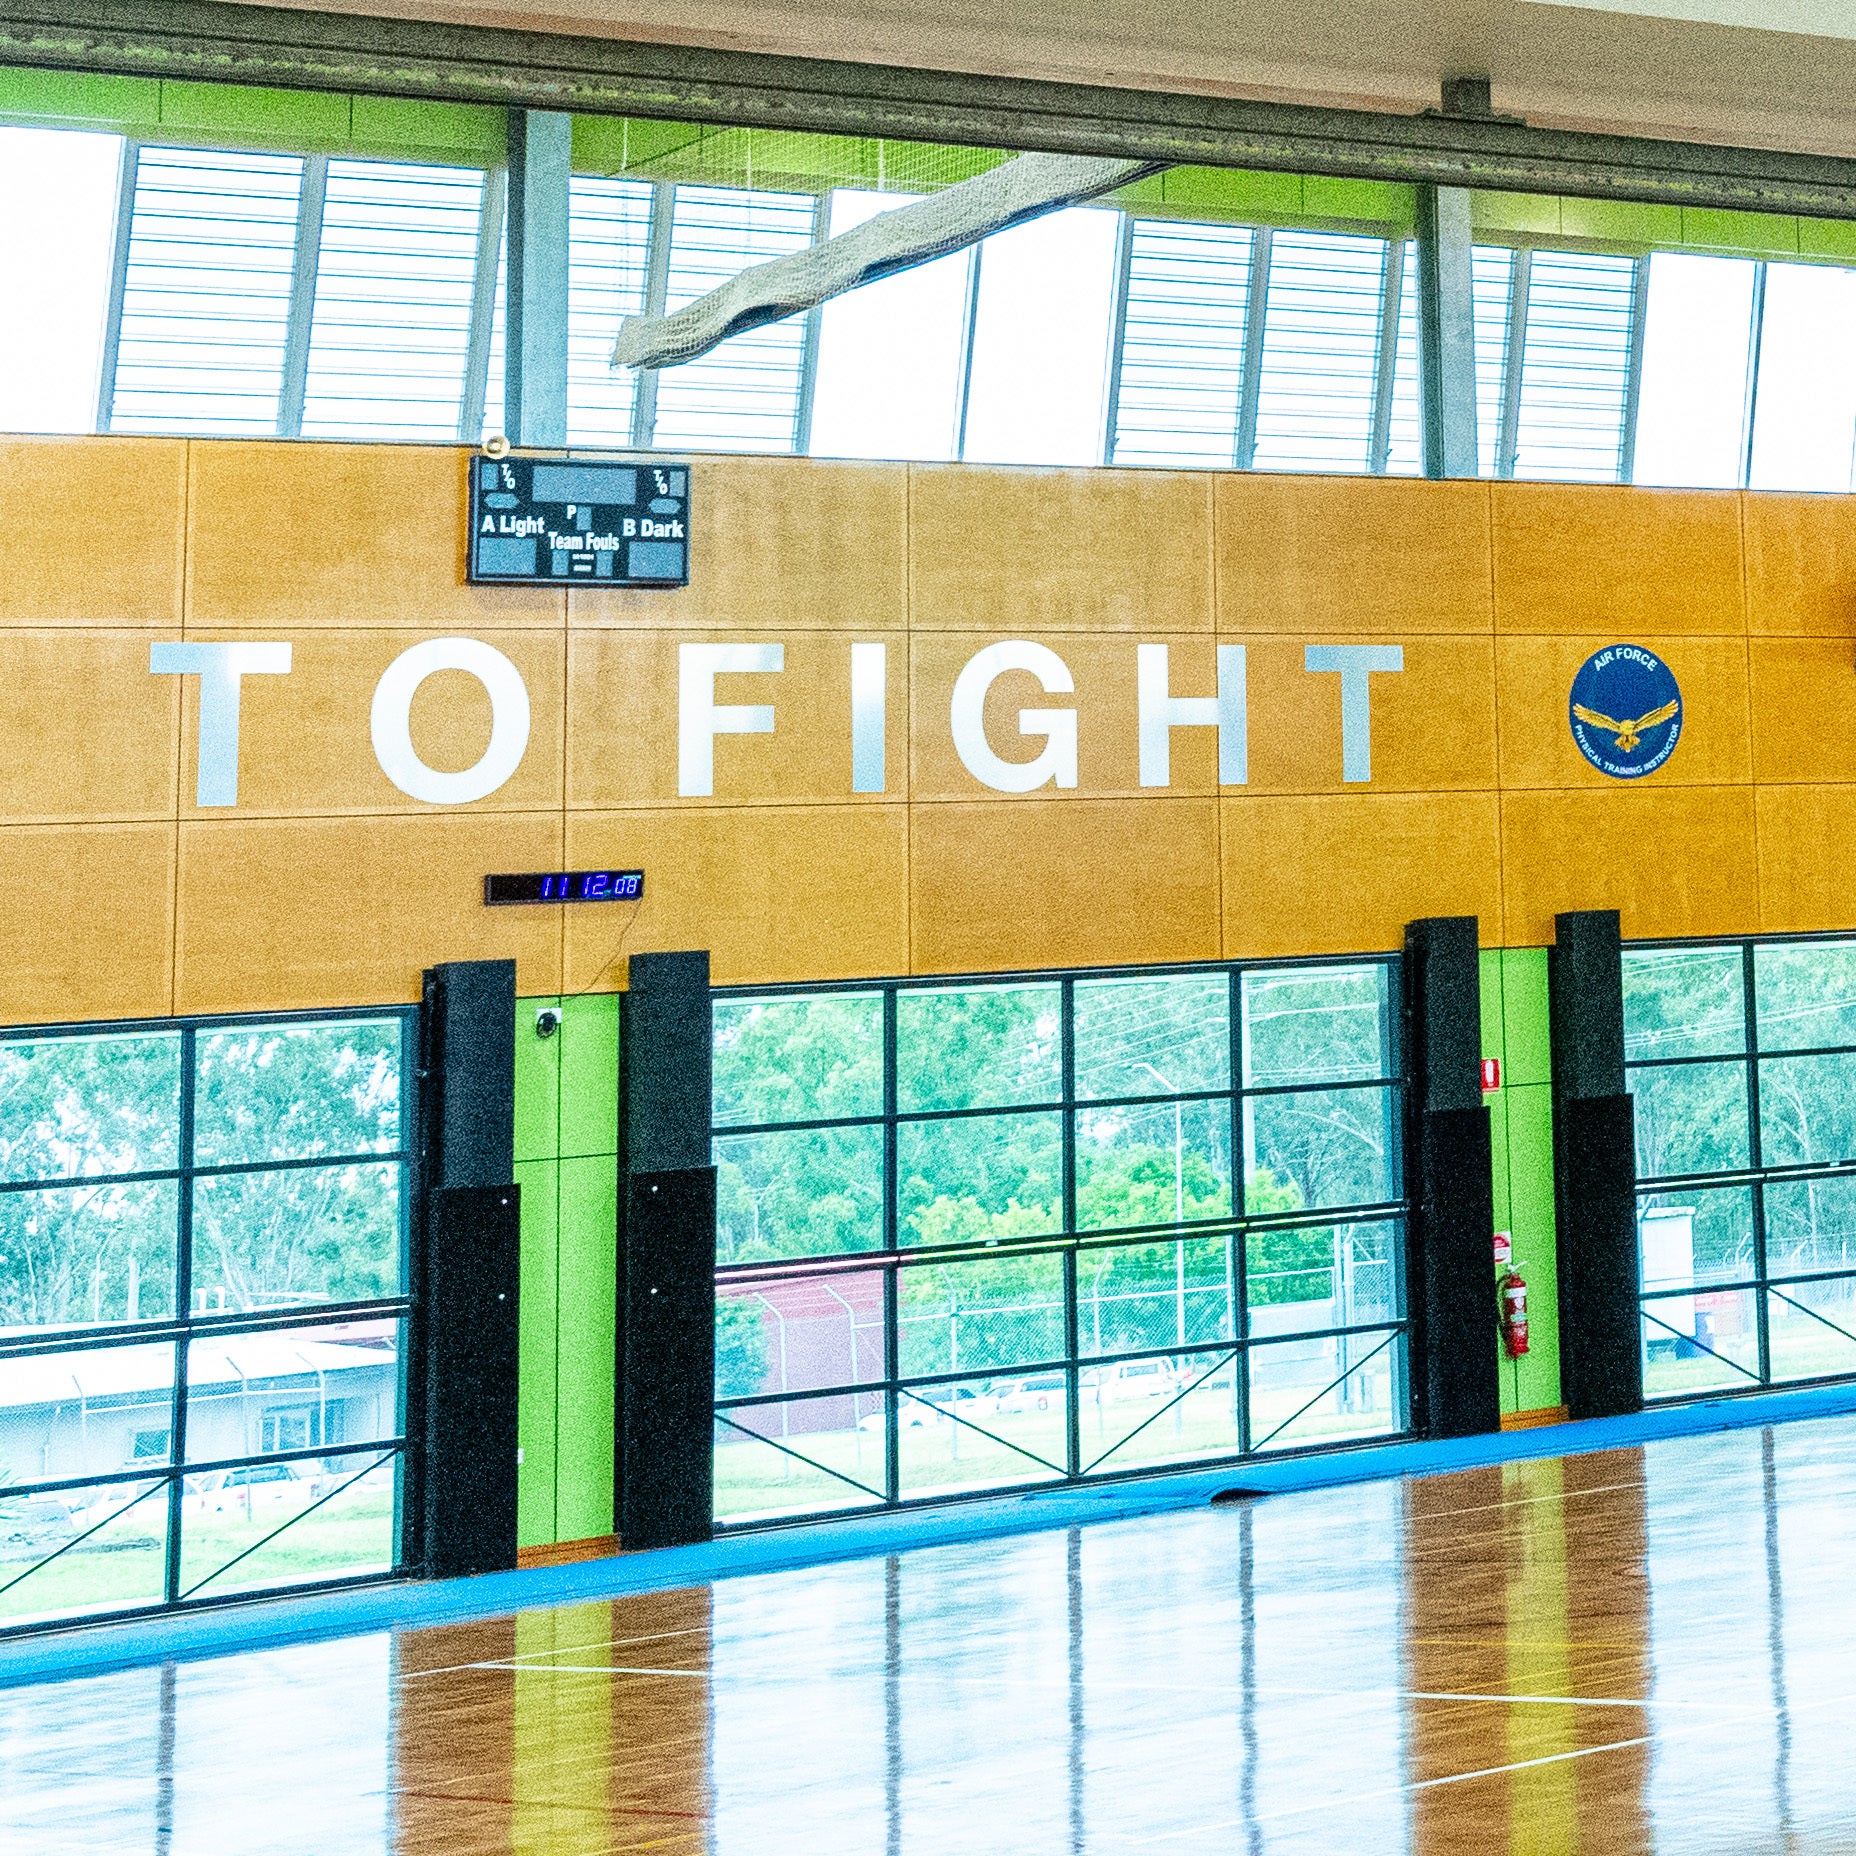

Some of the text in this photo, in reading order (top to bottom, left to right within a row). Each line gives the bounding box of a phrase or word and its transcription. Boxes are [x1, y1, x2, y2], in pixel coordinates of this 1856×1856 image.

[566, 504, 577, 520] P
[481, 515, 545, 538] A Light
[623, 518, 684, 538] B Dark
[549, 531, 620, 551] Team Fouls
[1594, 647, 1658, 672] AIR FORCE
[149, 635, 1404, 808] TO FIGHT
[1575, 724, 1679, 776] PHYSICAL TRAINING INSTRUCTOR
